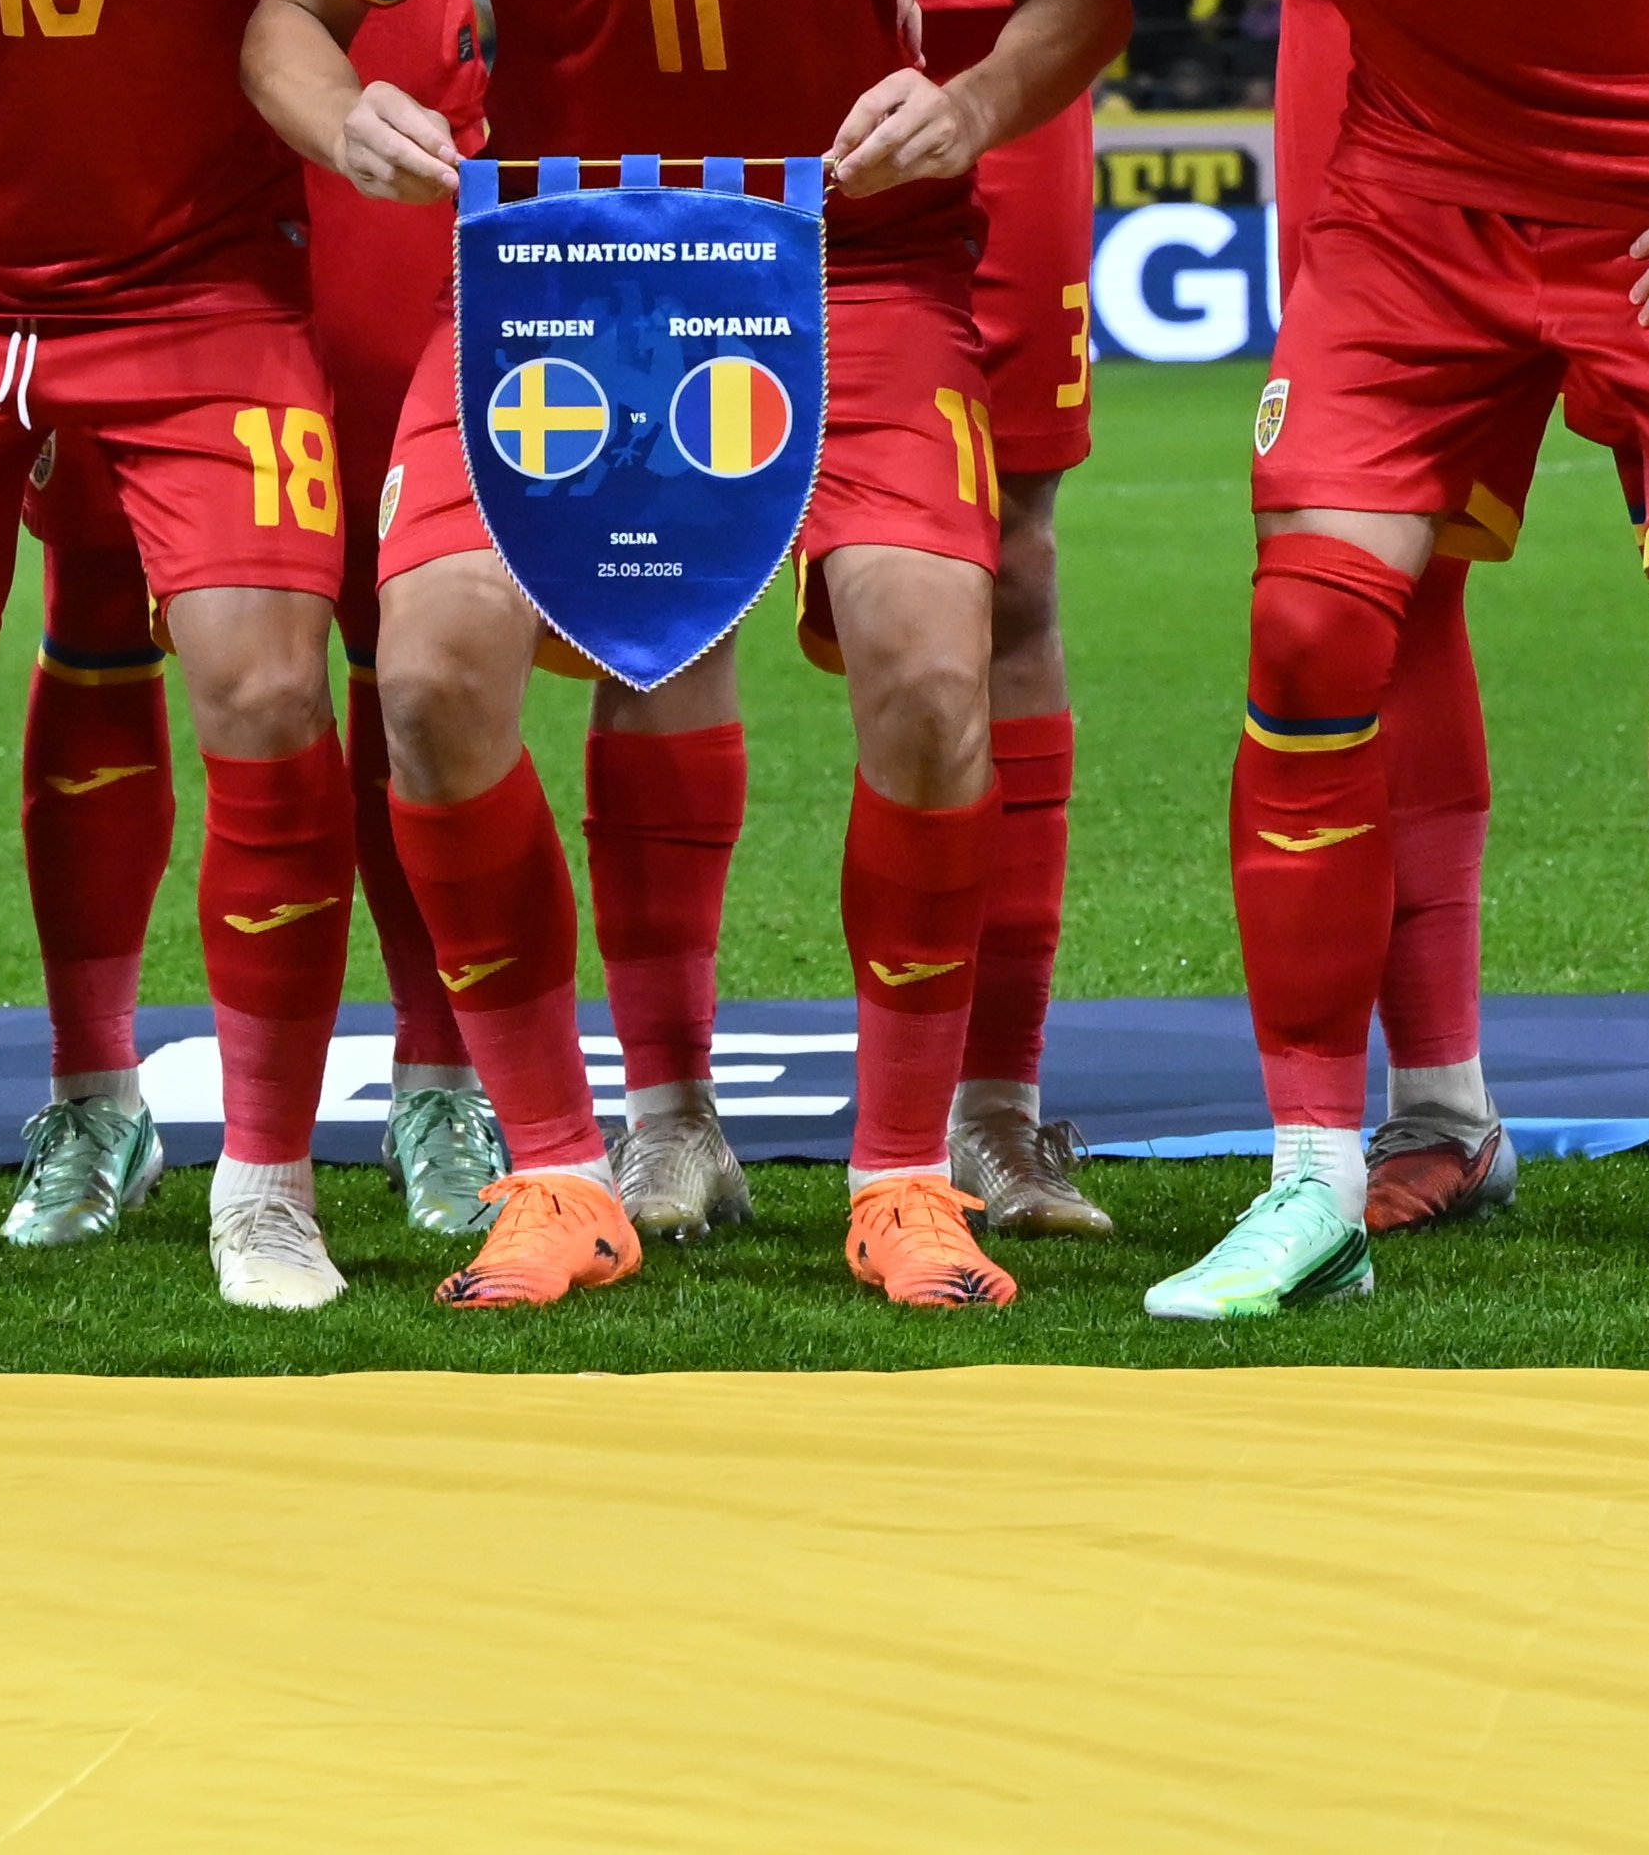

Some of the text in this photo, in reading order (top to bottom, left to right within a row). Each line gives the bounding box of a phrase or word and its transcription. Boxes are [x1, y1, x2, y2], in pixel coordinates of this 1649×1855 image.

[498, 242, 777, 263] UEFA NATIONS LEAGUE
[501, 320, 595, 337] SWEDEN
[669, 317, 792, 337] ROMANIA
[1056, 282, 1089, 408] 3
[934, 387, 999, 523] 11
[233, 407, 339, 537] 18
[610, 533, 658, 545] SOLNA
[598, 562, 683, 578] 25.09.2026
